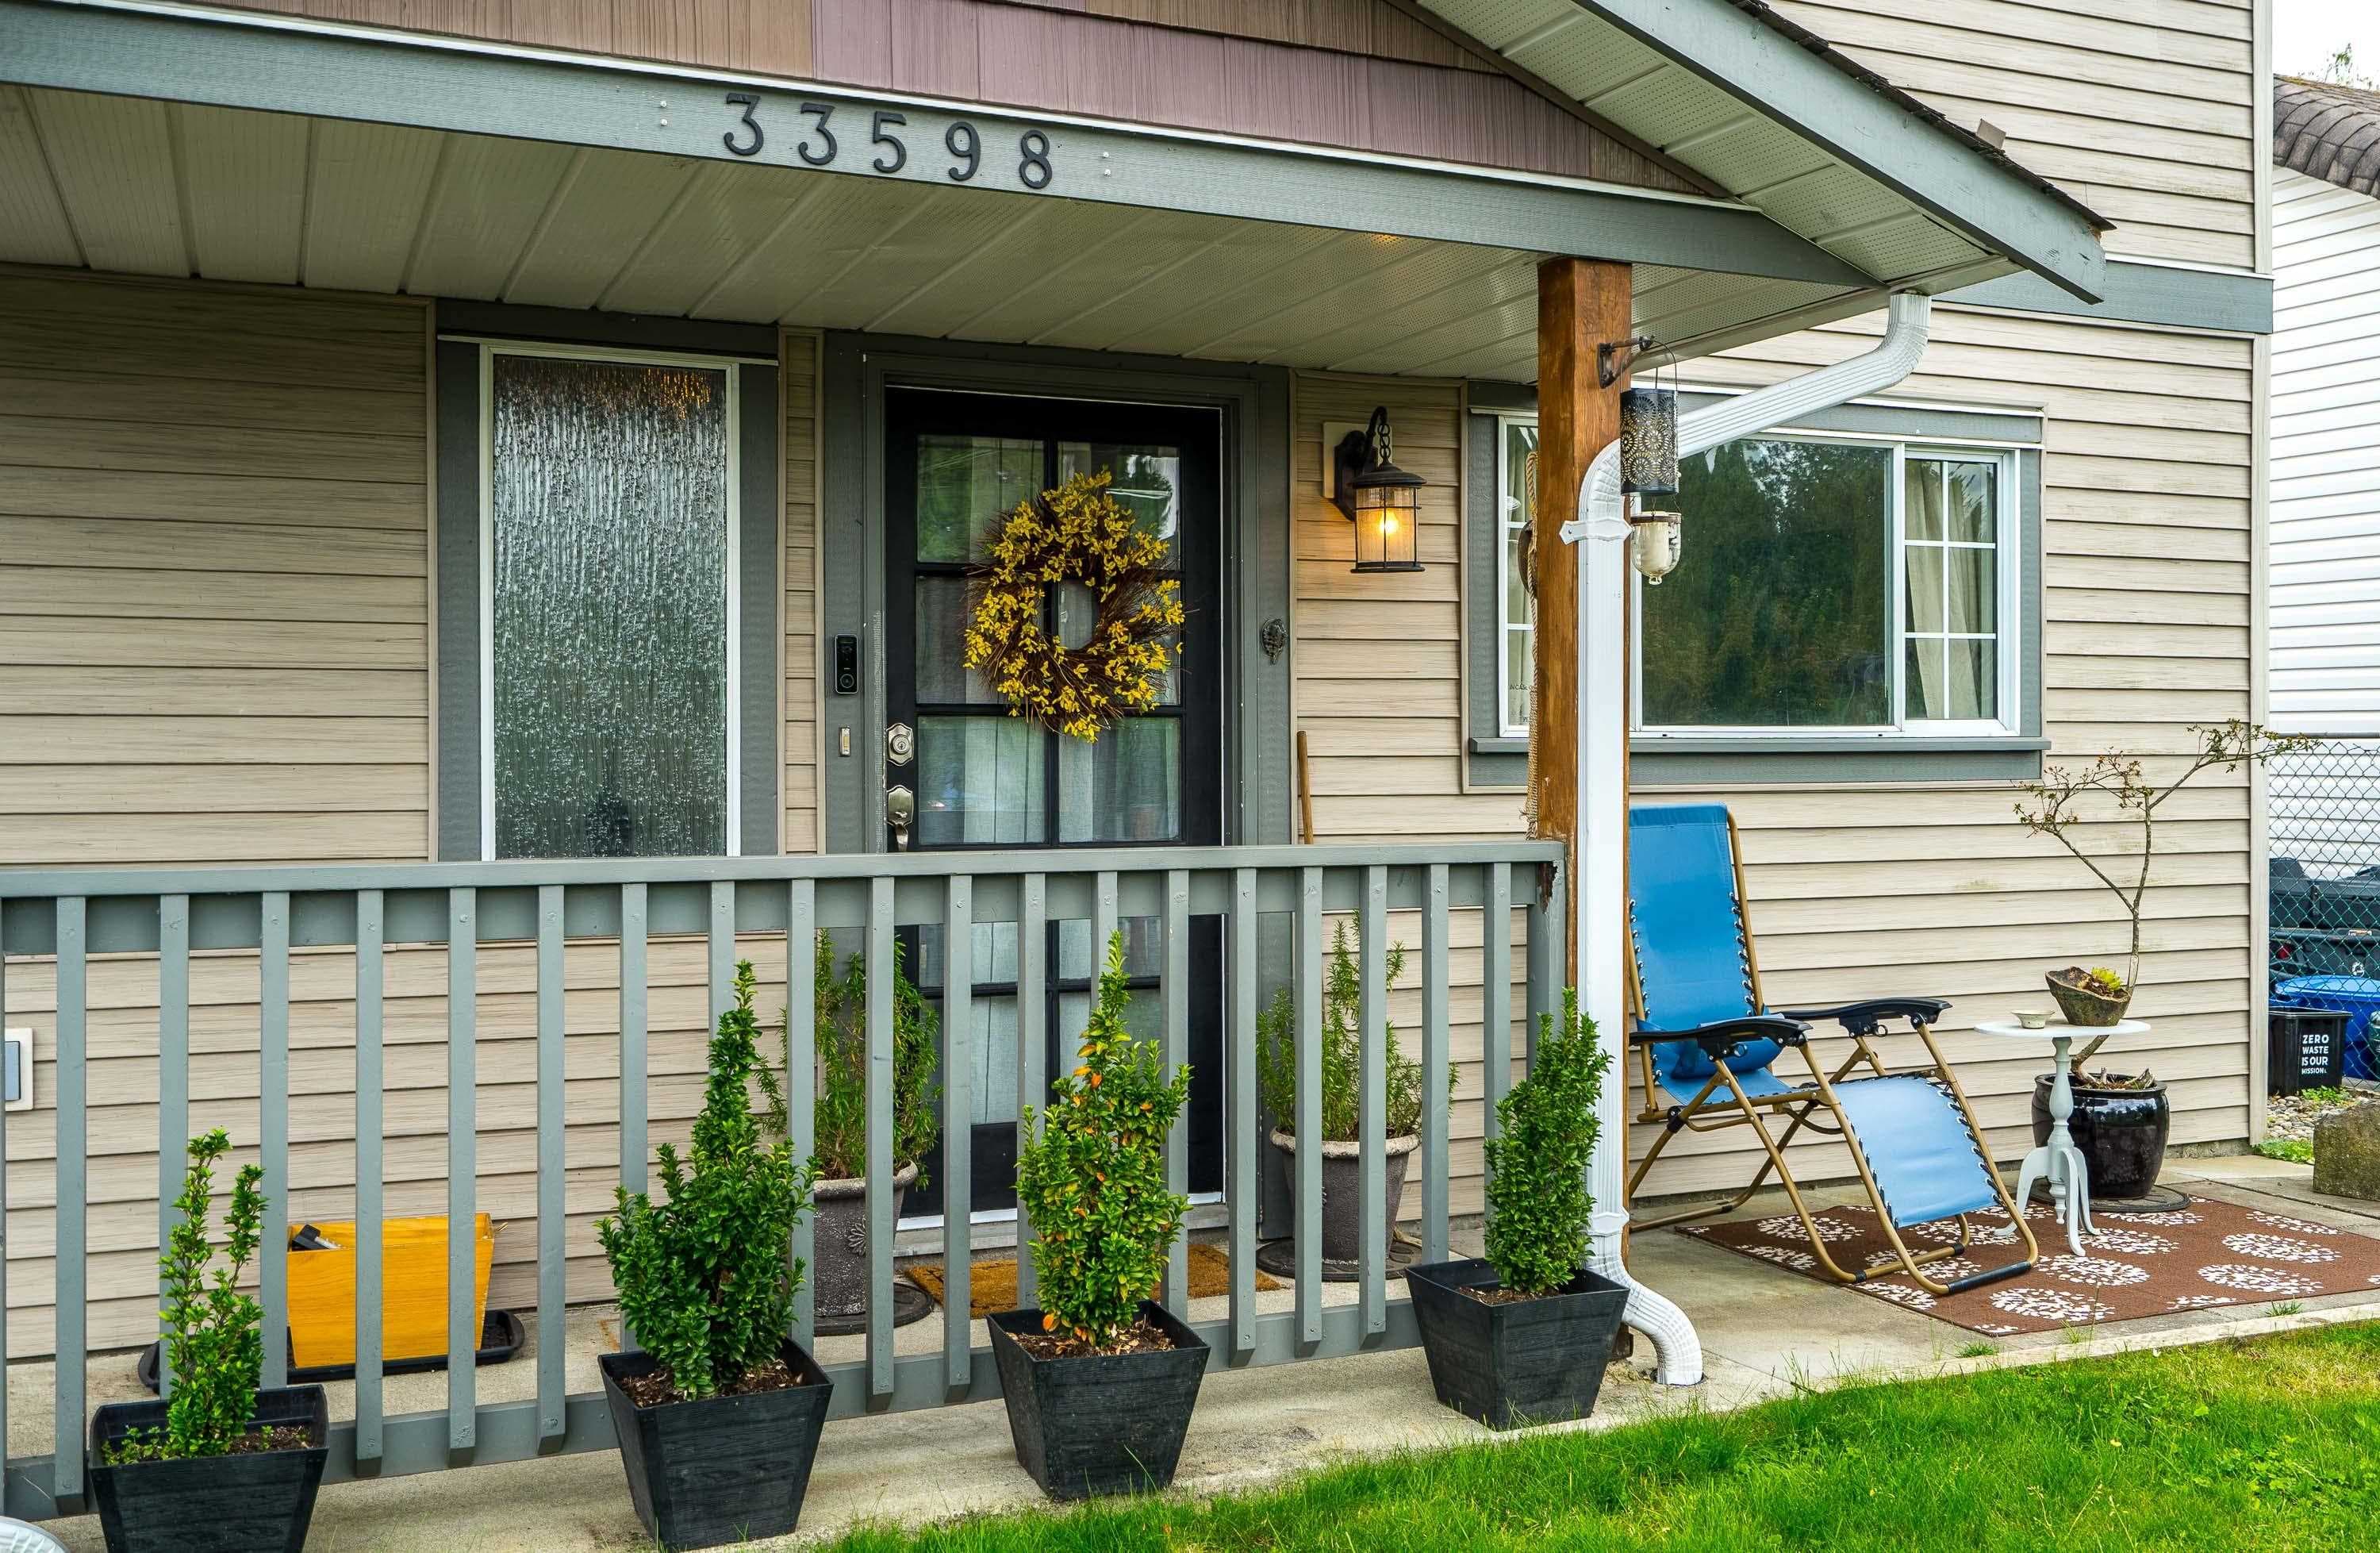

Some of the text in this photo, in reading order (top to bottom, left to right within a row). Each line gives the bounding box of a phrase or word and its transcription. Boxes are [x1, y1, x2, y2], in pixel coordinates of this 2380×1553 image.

[723, 92, 1053, 189] 33598
[2302, 1034, 2329, 1044] ZERO
[2301, 1056, 2328, 1067] IS OUR
